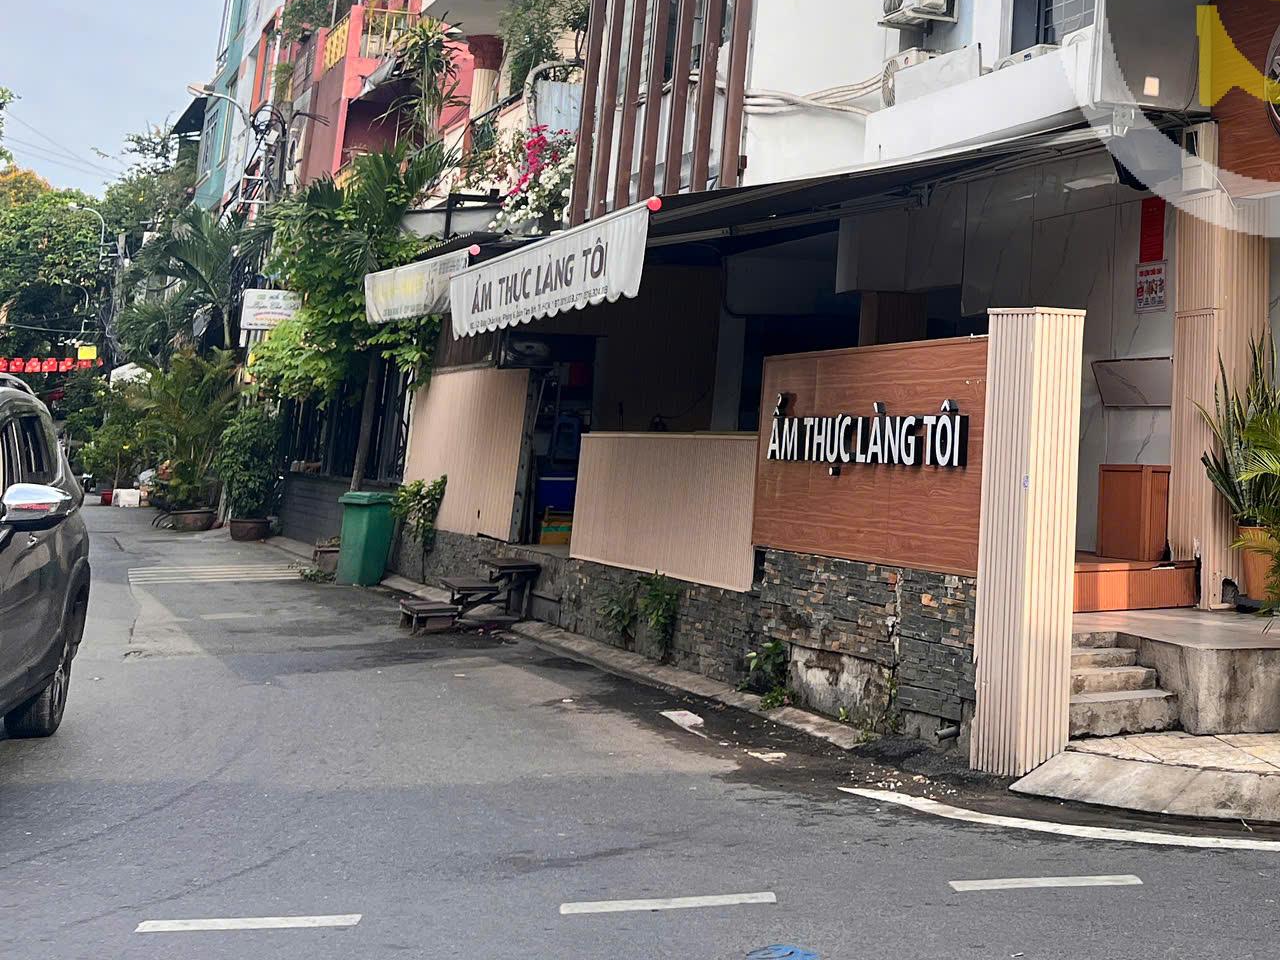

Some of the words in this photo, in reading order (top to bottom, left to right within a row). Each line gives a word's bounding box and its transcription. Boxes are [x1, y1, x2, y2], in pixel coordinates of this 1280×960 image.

[534, 253, 576, 297] LÀNG
[582, 237, 609, 282] TÔI
[767, 393, 798, 461] ẨM
[803, 413, 851, 476] THỰC
[855, 401, 915, 466] LÀNG
[923, 399, 961, 467] TÔI
